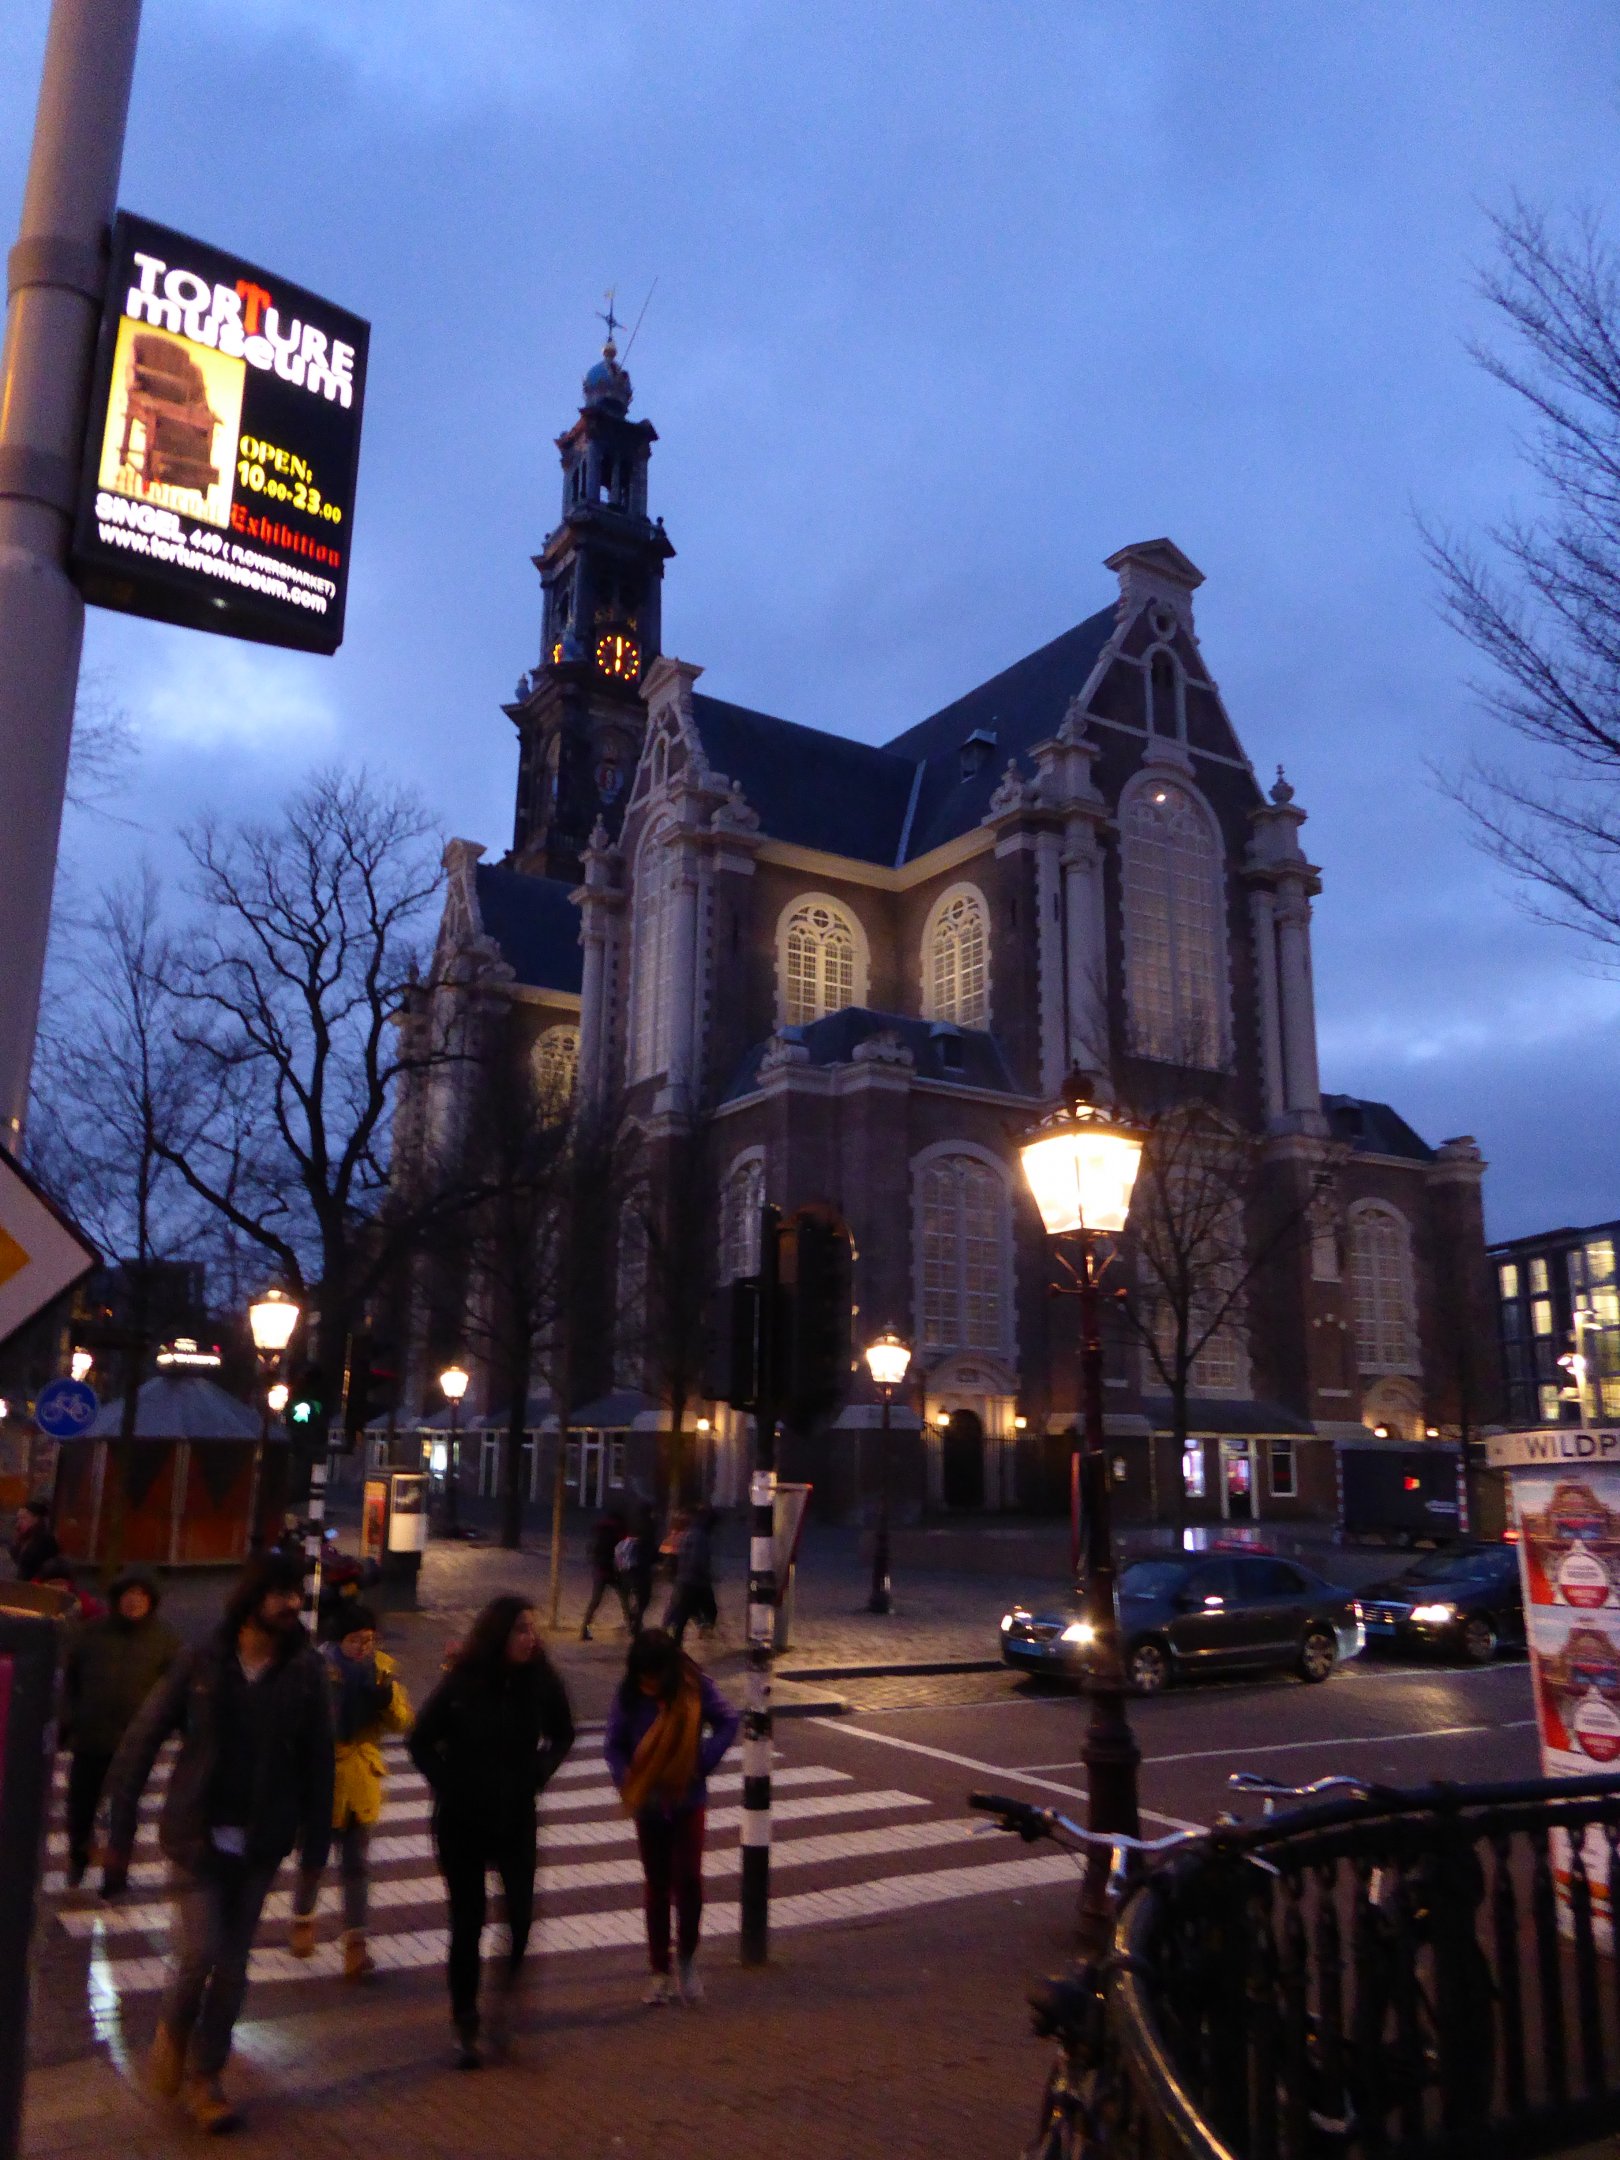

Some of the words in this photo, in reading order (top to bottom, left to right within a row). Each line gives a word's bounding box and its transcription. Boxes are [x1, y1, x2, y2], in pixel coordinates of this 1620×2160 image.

[126, 287, 353, 409] museum
[134, 252, 355, 381] TORTURE
[239, 434, 313, 484] OPEN:
[95, 492, 187, 544] SINGEL
[237, 460, 342, 524] 10.00-23.00
[98, 521, 328, 614] www.torturemuseum.com
[230, 502, 341, 569] Exhibition
[1524, 1433, 1620, 1459] WILDP
